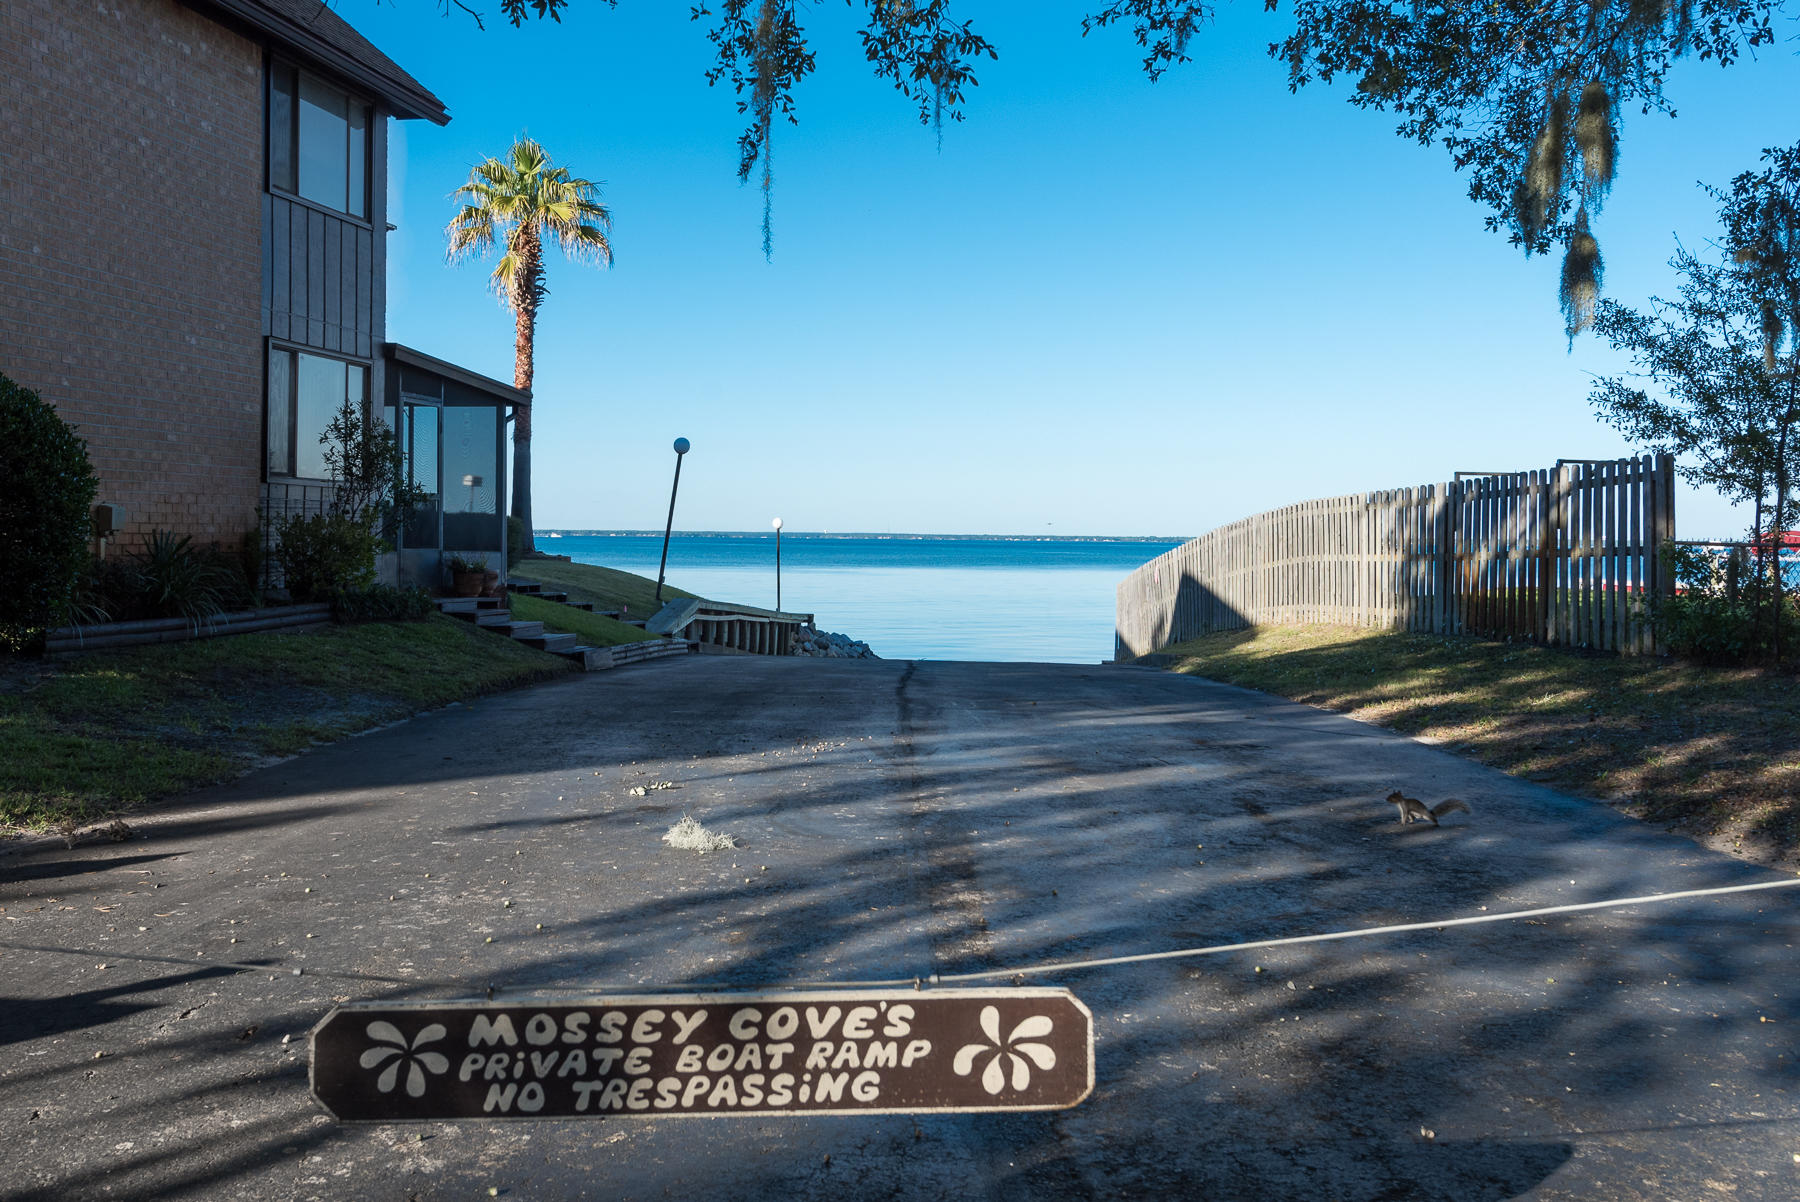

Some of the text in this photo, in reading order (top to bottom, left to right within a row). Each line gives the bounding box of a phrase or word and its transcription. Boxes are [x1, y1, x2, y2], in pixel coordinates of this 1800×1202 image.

[468, 1001, 915, 1047] MOSSEY COVE'S
[675, 1043, 794, 1073] BOAT
[805, 1039, 932, 1069] RAMP
[483, 1081, 545, 1112] NO
